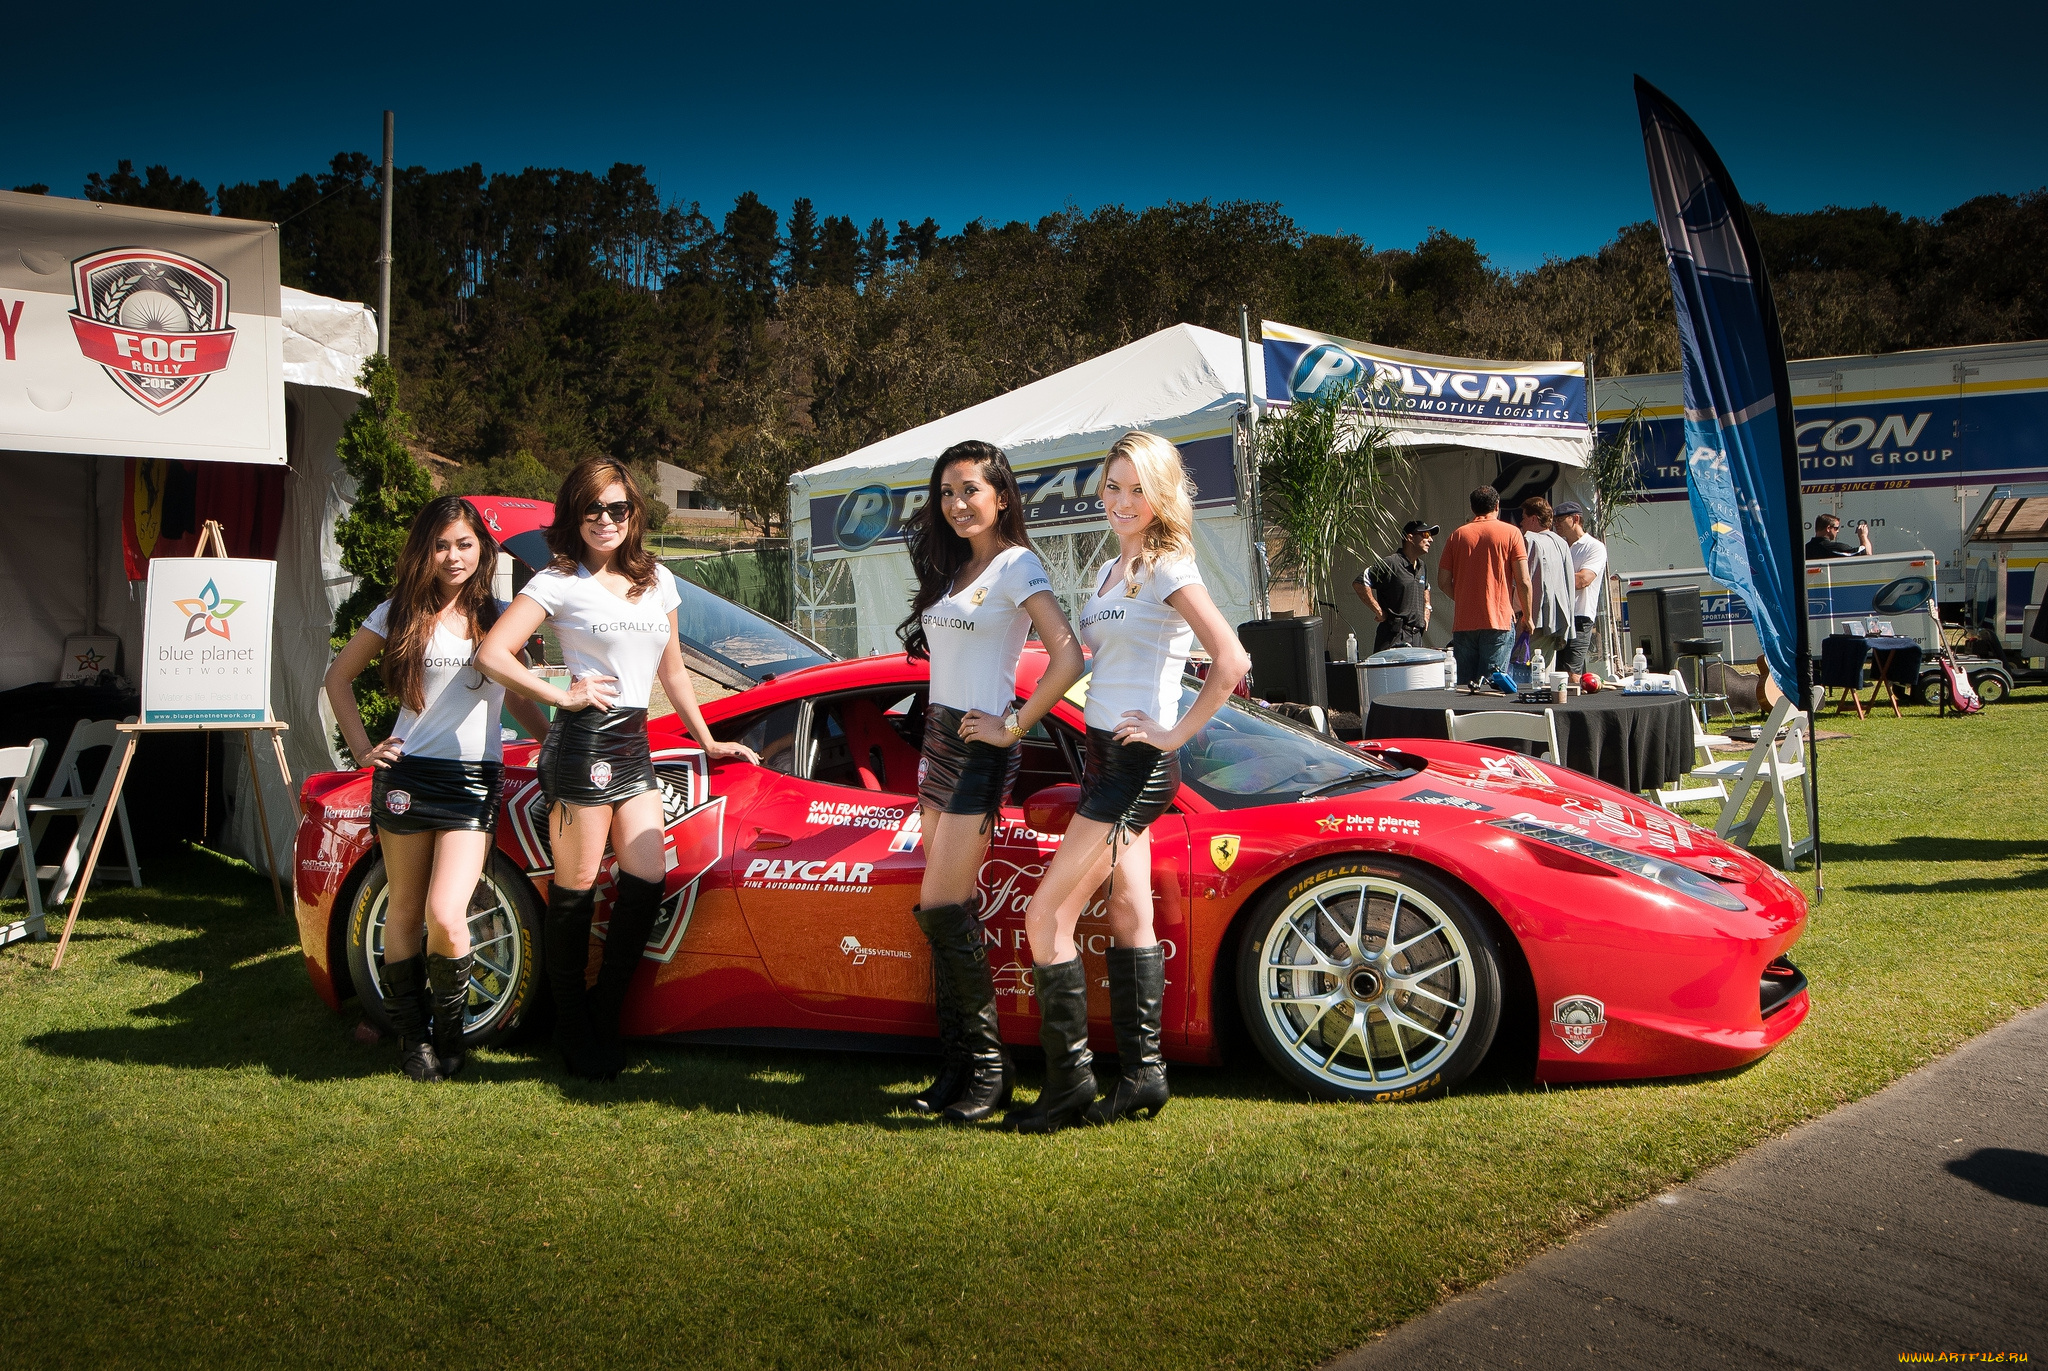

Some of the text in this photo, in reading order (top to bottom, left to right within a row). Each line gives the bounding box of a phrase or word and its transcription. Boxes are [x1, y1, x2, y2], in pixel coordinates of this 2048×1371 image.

[112, 332, 197, 362] FOG
[131, 360, 182, 374] RALLY
[140, 377, 174, 390] 2012
[1371, 362, 1540, 406] PLYCAR
[1362, 397, 1570, 420] AUTOMOTIVE LOGISTICS
[1870, 449, 1953, 464] GROUP
[1841, 481, 1877, 492] SINCE
[1884, 480, 1911, 490] 1982
[159, 646, 254, 664] blue planet
[160, 667, 253, 675] NETWORK
[154, 711, 256, 719] www.blueplanetnetwork.org
[809, 800, 904, 819] SAN FRANCISCO
[806, 813, 900, 831] MOTOR SPORTS
[1347, 814, 1420, 828] blue planet
[1346, 825, 1419, 836] NETWORK
[743, 858, 874, 883] PLYCAR
[743, 880, 873, 893] FINE AUTOMOBILE TRANSPORT
[1288, 865, 1358, 899] PIRELLI
[521, 928, 533, 999] PIRELLI
[1564, 1025, 1592, 1035] FOG
